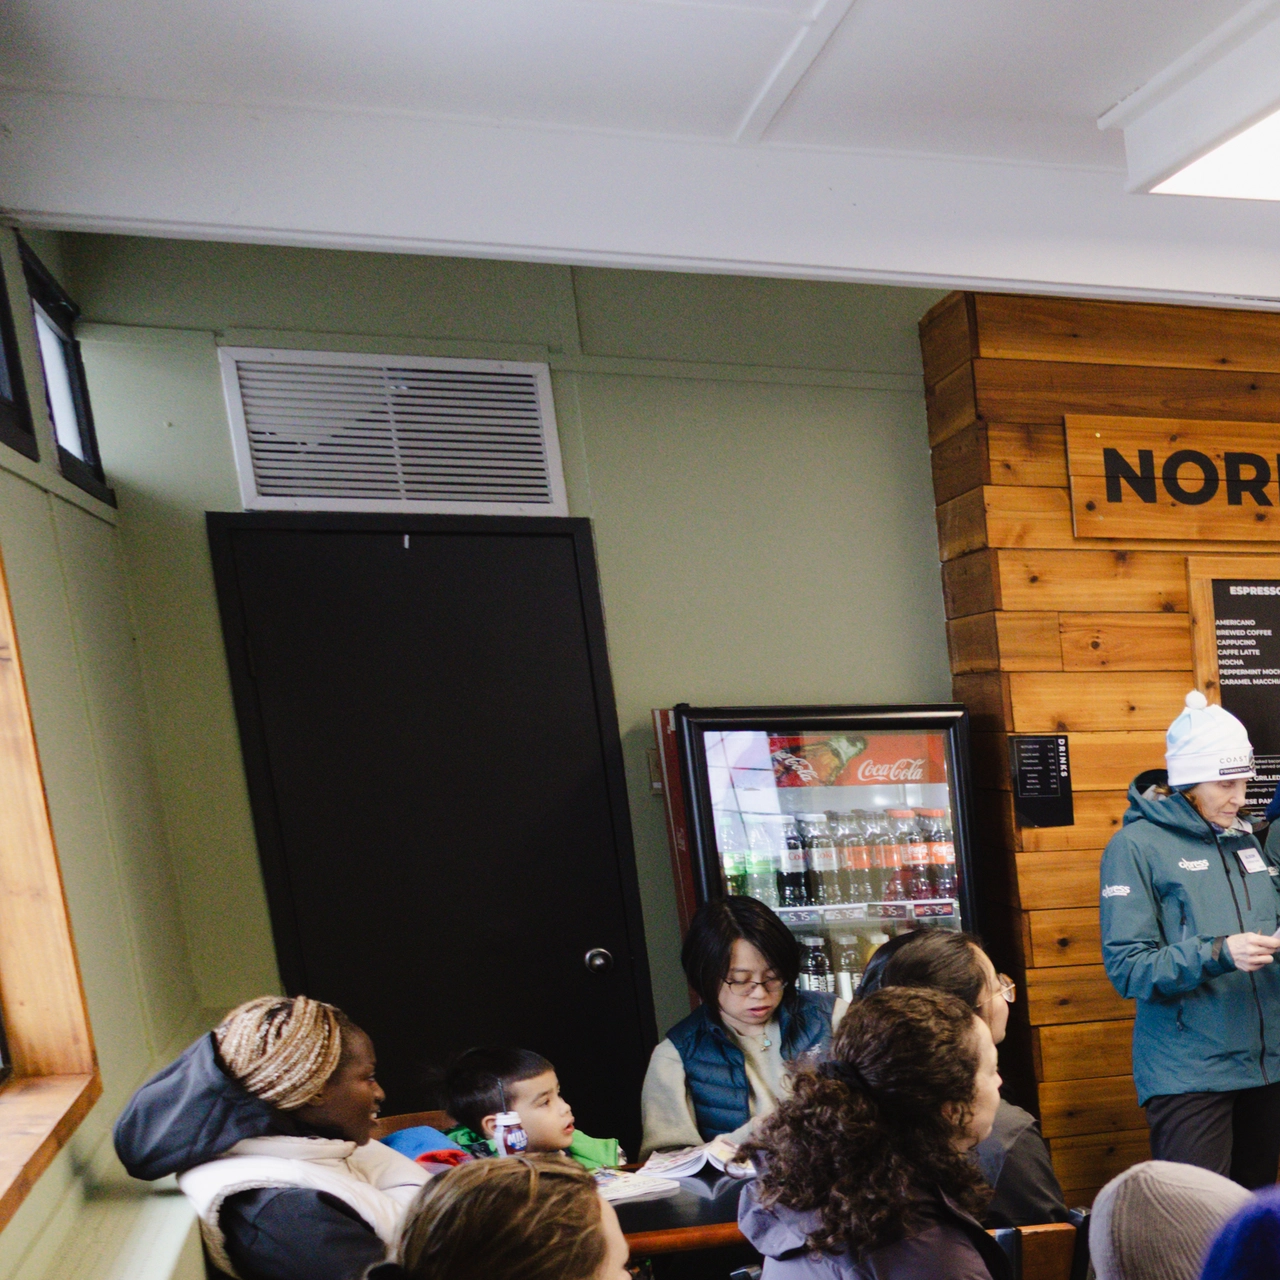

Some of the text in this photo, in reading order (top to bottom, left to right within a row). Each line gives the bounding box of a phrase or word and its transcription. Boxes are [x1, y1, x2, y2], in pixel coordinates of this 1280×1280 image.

[1215, 619, 1256, 627] AMERICANO
[1216, 629, 1272, 637] BREWED COFFEE
[1057, 738, 1069, 777] DRINKS
[1219, 755, 1248, 764] COAST
[877, 906, 898, 915] 5.75
[923, 905, 944, 915] 5.75
[788, 912, 811, 922] 5.75
[833, 911, 854, 920] 5.75
